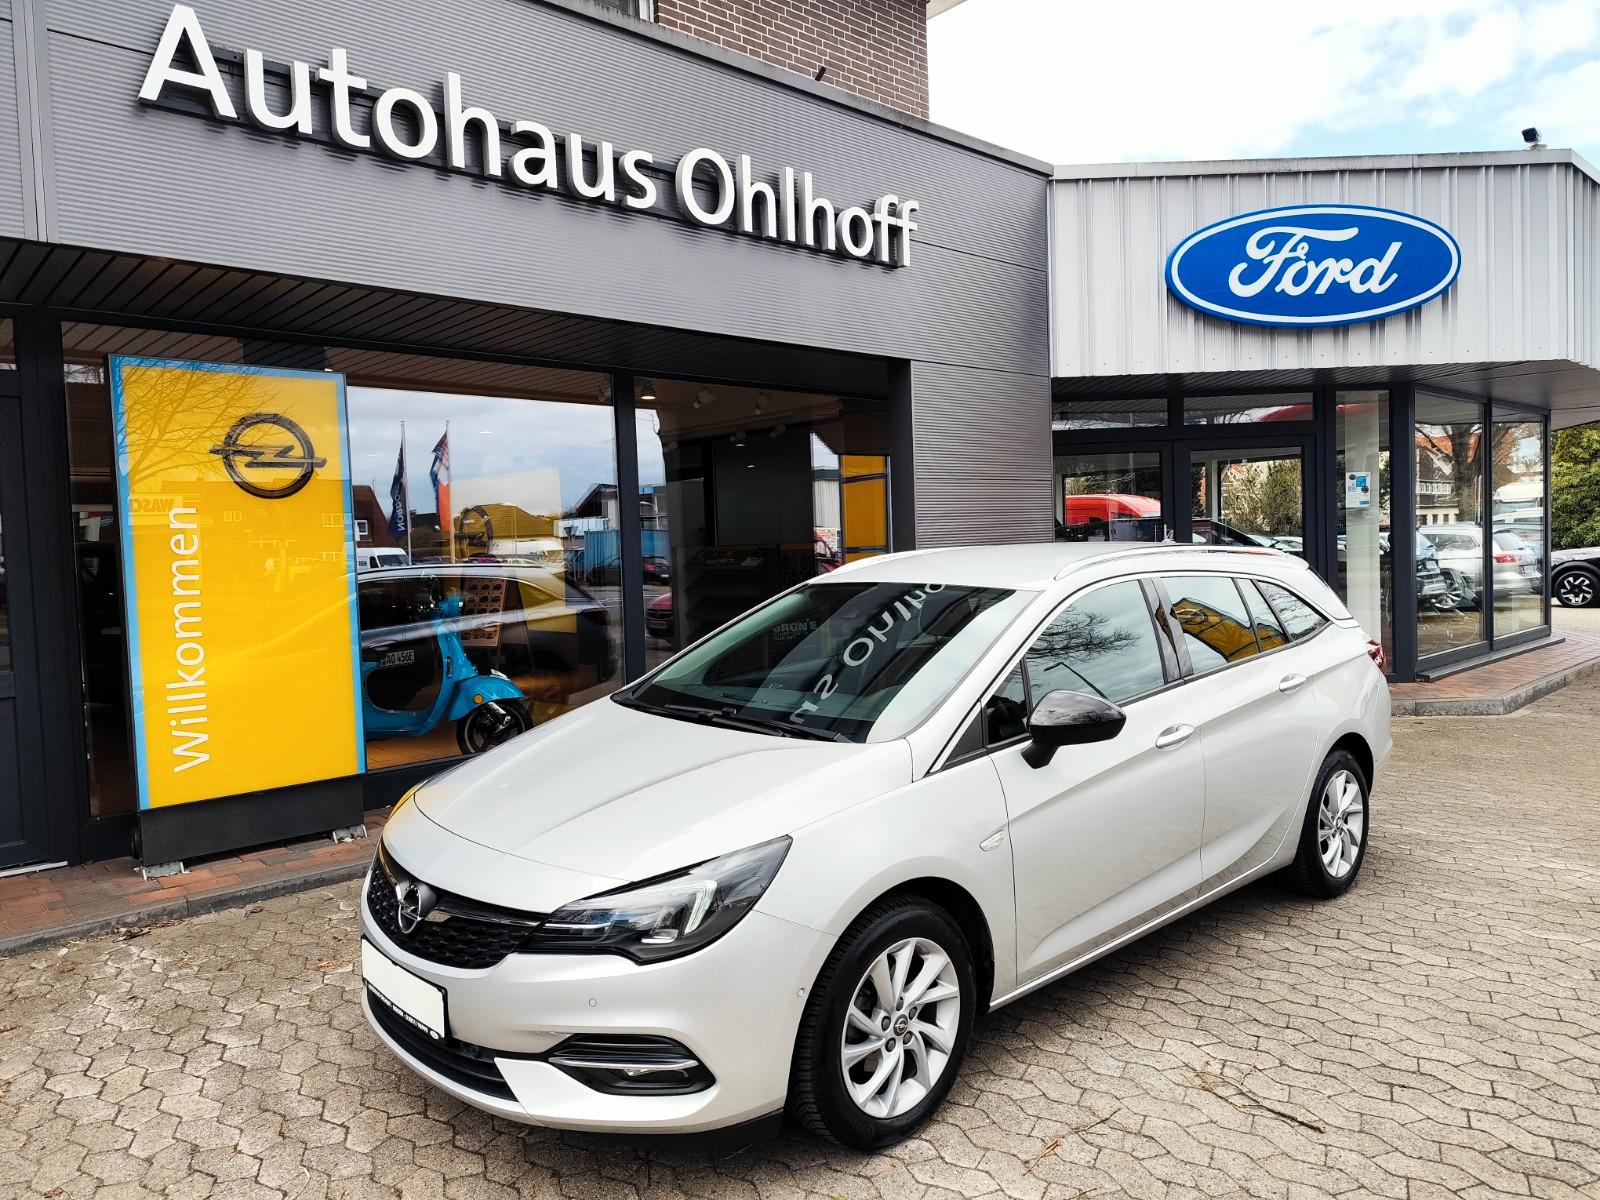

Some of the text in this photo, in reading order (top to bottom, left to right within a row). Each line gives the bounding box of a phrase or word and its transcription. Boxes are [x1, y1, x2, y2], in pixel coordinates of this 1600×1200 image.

[137, 4, 919, 267] Autohaus Ohlhoff
[1228, 226, 1402, 297] Ford
[166, 507, 210, 773] Willkommen
